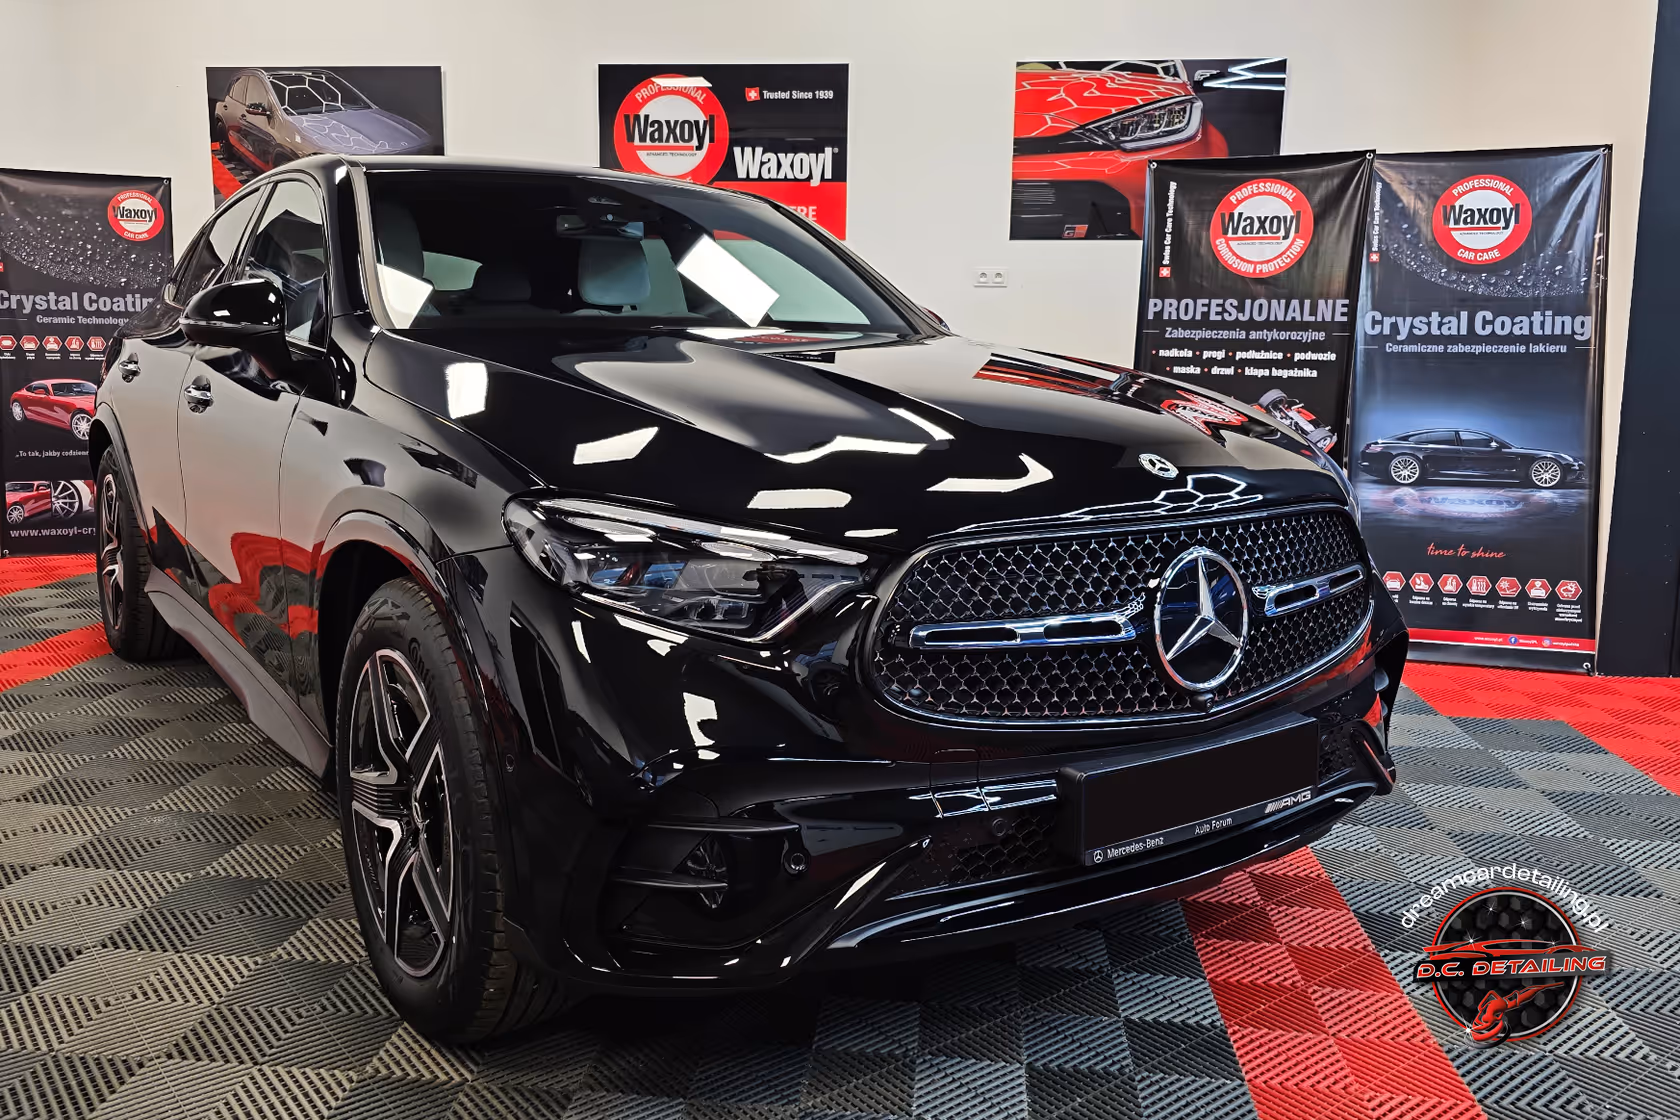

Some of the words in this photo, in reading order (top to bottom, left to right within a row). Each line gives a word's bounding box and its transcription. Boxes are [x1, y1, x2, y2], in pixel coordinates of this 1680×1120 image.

[763, 90, 790, 99] Trusted
[792, 90, 813, 99] Since
[815, 90, 834, 99] 1939
[623, 114, 715, 151] Waxoyl
[1229, 182, 1297, 204] PROFESSIONAL
[1452, 178, 1514, 197] PROFESSIONAL
[112, 206, 157, 223] Waxoyl
[1442, 203, 1520, 230] Waxoyl
[1165, 217, 1173, 233] Care
[1220, 210, 1301, 240] Waxoyl
[1164, 233, 1172, 245] Car
[1215, 238, 1255, 273] CORROSION
[1256, 238, 1305, 273] PROTECTION
[1457, 248, 1475, 261] CAR
[1476, 248, 1501, 261] CARE
[0, 289, 79, 314] Crystal
[83, 291, 154, 312] Coati
[1147, 298, 1349, 322] PROFESJONALNE
[36, 314, 76, 324] Ceramic
[77, 315, 129, 327] Technology
[1363, 309, 1467, 341] Crystal
[1474, 309, 1592, 341] Coating
[1164, 327, 1246, 341] Zabezpieczenia
[1249, 328, 1326, 343] antykorozyjne
[1202, 349, 1226, 360] progi
[1235, 350, 1284, 361] podłużnice
[1294, 351, 1337, 362] podwozie
[1385, 342, 1444, 353] Ceramiczne
[1446, 342, 1526, 355] zabezpieczenie
[1529, 342, 1567, 353] lakieru
[1173, 365, 1201, 374] maska
[1211, 365, 1235, 375] drzwi
[1244, 366, 1270, 378] klapa
[1271, 367, 1318, 379] bagażnika
[42, 449, 60, 458] jakby
[1427, 542, 1456, 556] time
[1457, 543, 1470, 557] to
[1470, 546, 1507, 559] shine
[1279, 790, 1311, 807] AMG
[1194, 825, 1211, 836] Auto
[1211, 817, 1233, 831] Forum
[1107, 836, 1164, 859] Mercedes-Benz
